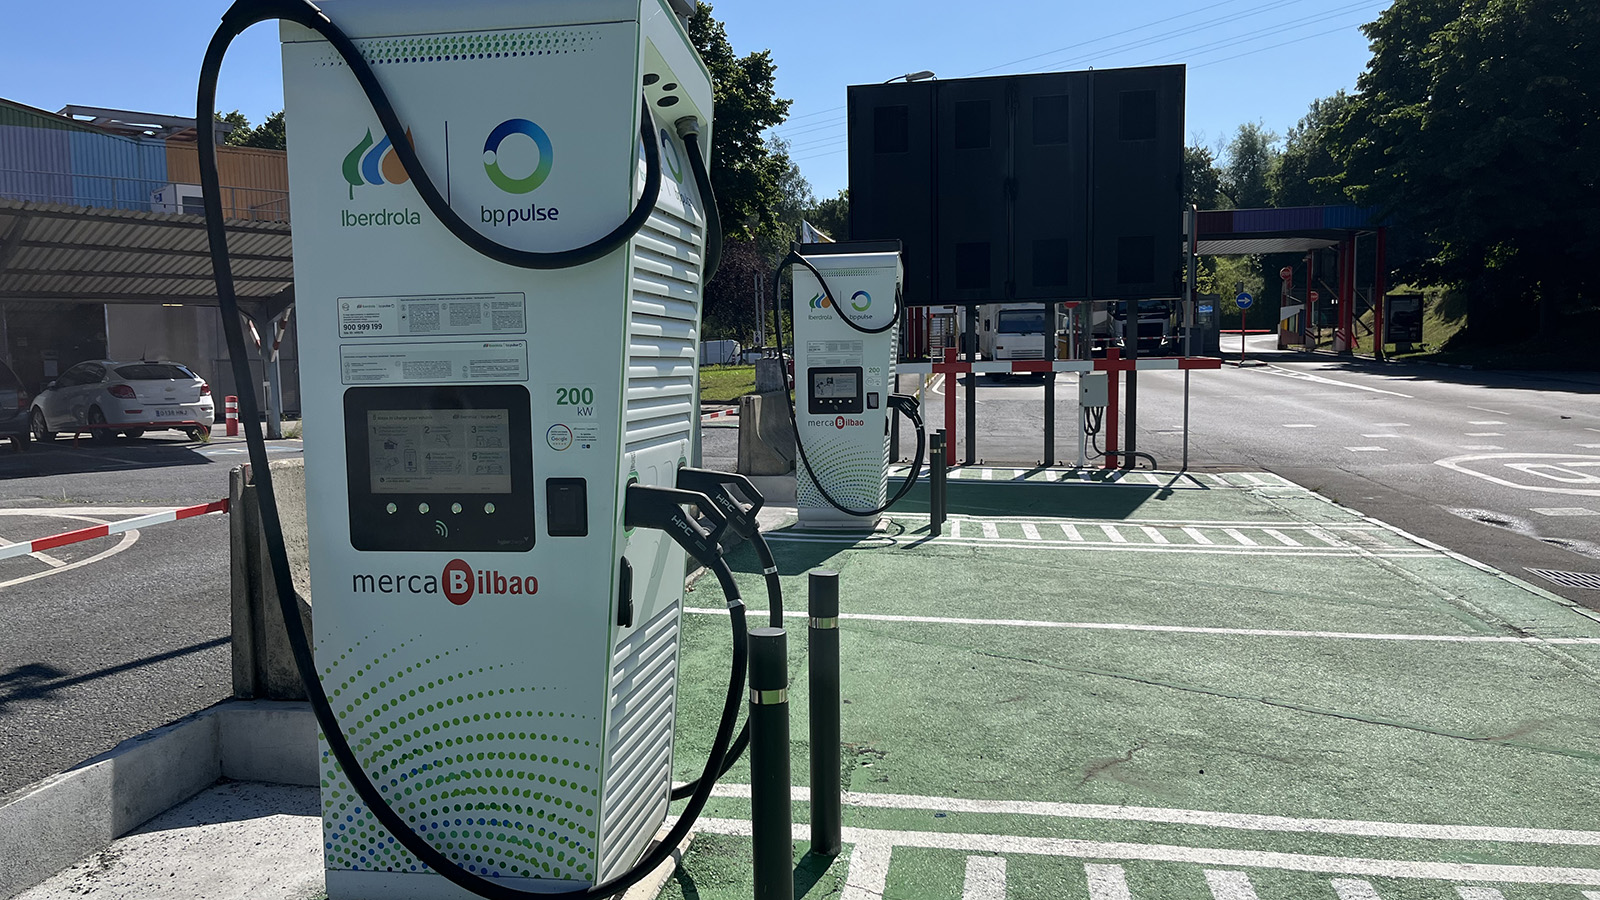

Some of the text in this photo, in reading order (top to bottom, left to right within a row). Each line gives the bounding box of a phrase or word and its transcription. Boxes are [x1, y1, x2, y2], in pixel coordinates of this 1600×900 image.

[341, 208, 421, 227] Iberdrola
[357, 323, 370, 331] 999
[556, 388, 594, 405] 200
[577, 407, 593, 416] kW
[424, 425, 430, 434] 2
[471, 425, 477, 434] 3
[425, 452, 431, 460] 4
[472, 452, 477, 460] 5
[715, 494, 735, 512] HPC
[671, 515, 693, 536] HPC
